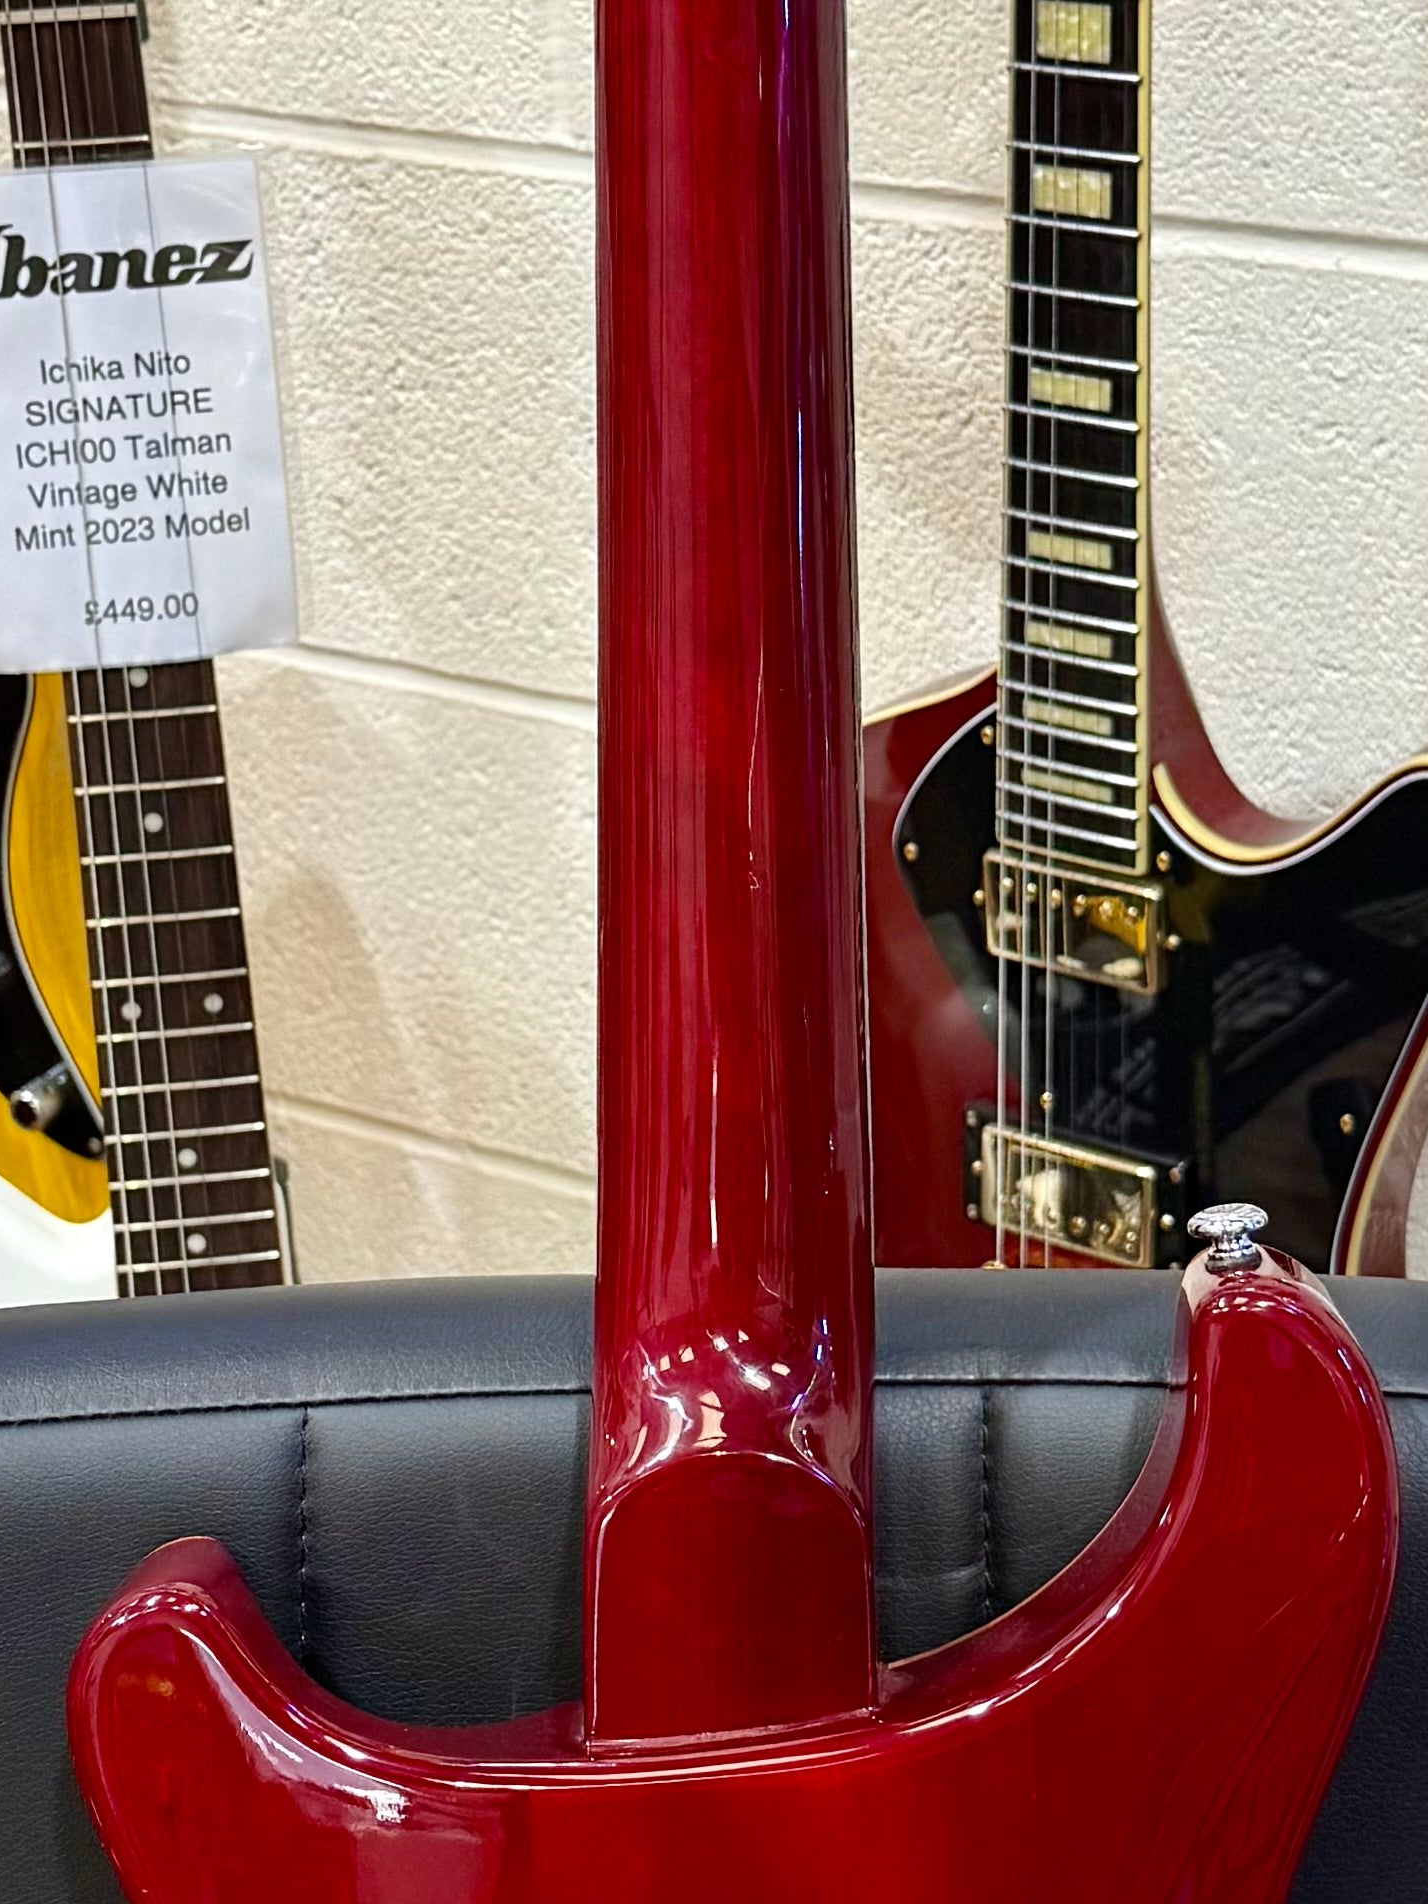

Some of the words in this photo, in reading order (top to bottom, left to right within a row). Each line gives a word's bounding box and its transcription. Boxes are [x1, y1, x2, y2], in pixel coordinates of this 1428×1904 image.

[39, 354, 124, 386] Ichika
[134, 351, 191, 378] Nito
[25, 388, 213, 427] SIGNATURE
[124, 431, 232, 463] Talman
[27, 481, 137, 512] Vintage
[146, 471, 228, 500] White
[15, 524, 75, 552] Mint
[85, 515, 155, 547] 2023
[166, 507, 250, 539] Model
[84, 592, 199, 626] £449.00
